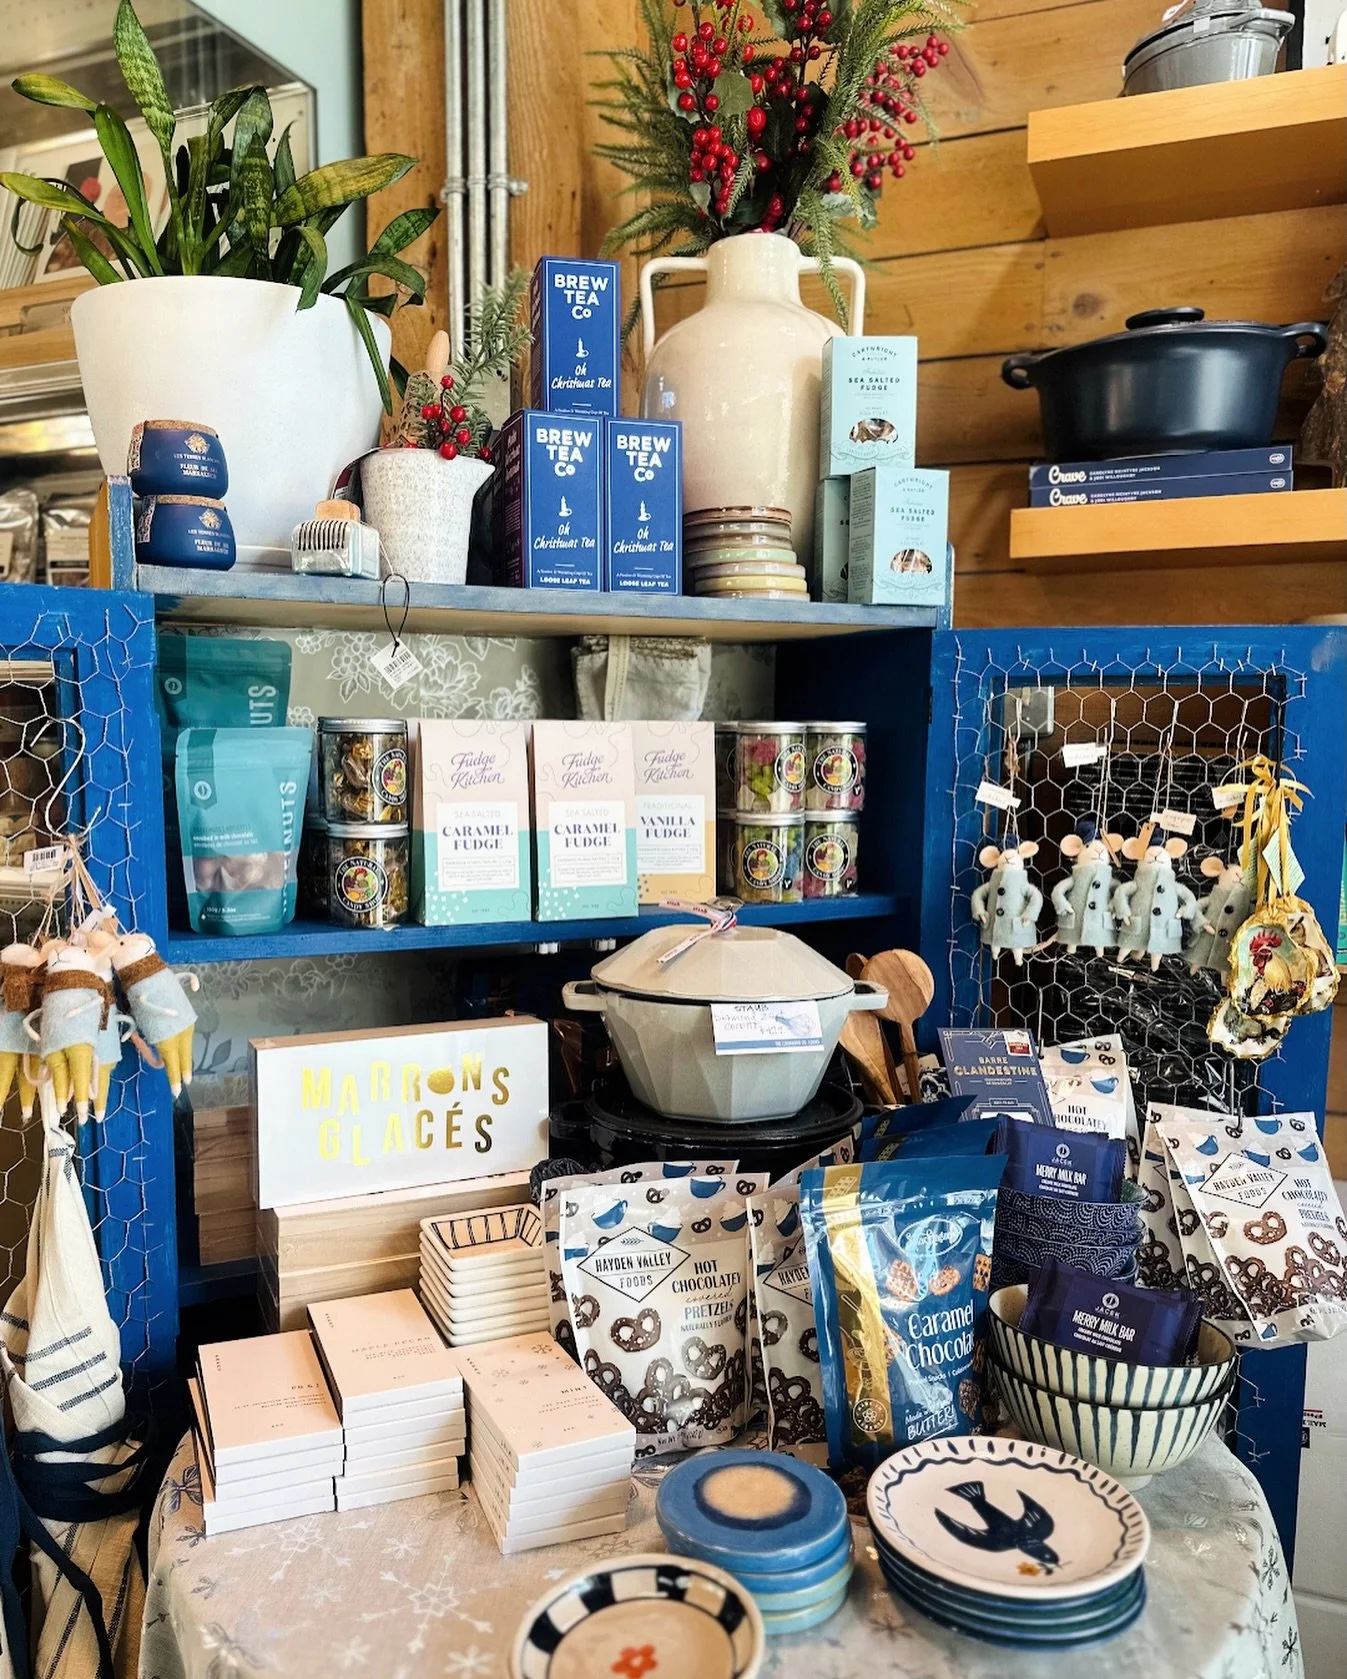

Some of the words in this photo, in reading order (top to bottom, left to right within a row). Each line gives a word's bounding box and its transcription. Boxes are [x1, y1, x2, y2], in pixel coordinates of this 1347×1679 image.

[554, 274, 608, 292] BREW
[564, 289, 600, 306] TEA
[571, 306, 592, 320] Co
[574, 363, 587, 376] Oh
[551, 375, 593, 390] Christmas
[596, 376, 612, 389] Tea
[536, 427, 592, 448] BREW
[617, 434, 671, 453] BREW
[546, 444, 584, 463] TEA
[626, 451, 662, 468] TEA
[554, 462, 576, 476] Co
[634, 467, 655, 482] Co
[1048, 465, 1088, 486] Crave
[1050, 488, 1088, 507] Crave
[558, 521, 571, 536] Oh
[637, 526, 649, 540] Oh
[533, 536, 577, 550] Christmas
[581, 537, 596, 549] Tea
[613, 540, 657, 554] Christmas
[660, 541, 675, 552] Tea
[540, 577, 561, 585] LOOSE
[578, 578, 591, 586] TEA
[657, 580, 670, 588] TEA
[450, 751, 496, 773] Fudge
[561, 752, 605, 772] Fudge
[643, 749, 686, 770] Fudge
[450, 768, 505, 791] Kitchen
[561, 768, 613, 790] Kitchen
[643, 764, 694, 785] Kitchen
[554, 822, 621, 836] CARAMEL
[641, 815, 696, 828] VANILLA
[442, 823, 514, 838] CARAMEL
[645, 828, 691, 840] FUDGE
[454, 838, 504, 850] FUDGE
[565, 836, 612, 849] FUDGE
[349, 859, 380, 873] NATURAL
[342, 895, 364, 911] CANDY
[978, 1056, 1009, 1064] BARRE
[953, 1065, 1038, 1076] CLANDESTINE
[1068, 1104, 1088, 1116] HOT
[319, 1102, 494, 1167] GLACÉS
[1036, 1164, 1058, 1180] MERRY
[1058, 1168, 1074, 1183] MILK
[1073, 1172, 1087, 1186] BAR
[1212, 1177, 1248, 1192] HAYDEN
[1246, 1172, 1276, 1184] VALLEY
[1293, 1178, 1312, 1188] HOT
[1237, 1186, 1268, 1201] FOODS
[595, 1256, 634, 1273] HAYDEN
[636, 1251, 673, 1268] VALLEY
[693, 1260, 719, 1275] HOT
[619, 1274, 654, 1289] FOODS
[671, 1272, 742, 1294] CHOCOLATEY
[684, 1298, 735, 1320] PRETZELS
[1095, 1305, 1121, 1319] JACEK
[908, 1299, 974, 1340] Caramel
[1072, 1309, 1099, 1330] MERRY
[1098, 1318, 1120, 1337] MILK
[1119, 1326, 1136, 1343] BAR
[560, 1385, 588, 1395] MINT
[907, 1404, 955, 1441] BUTTER!
